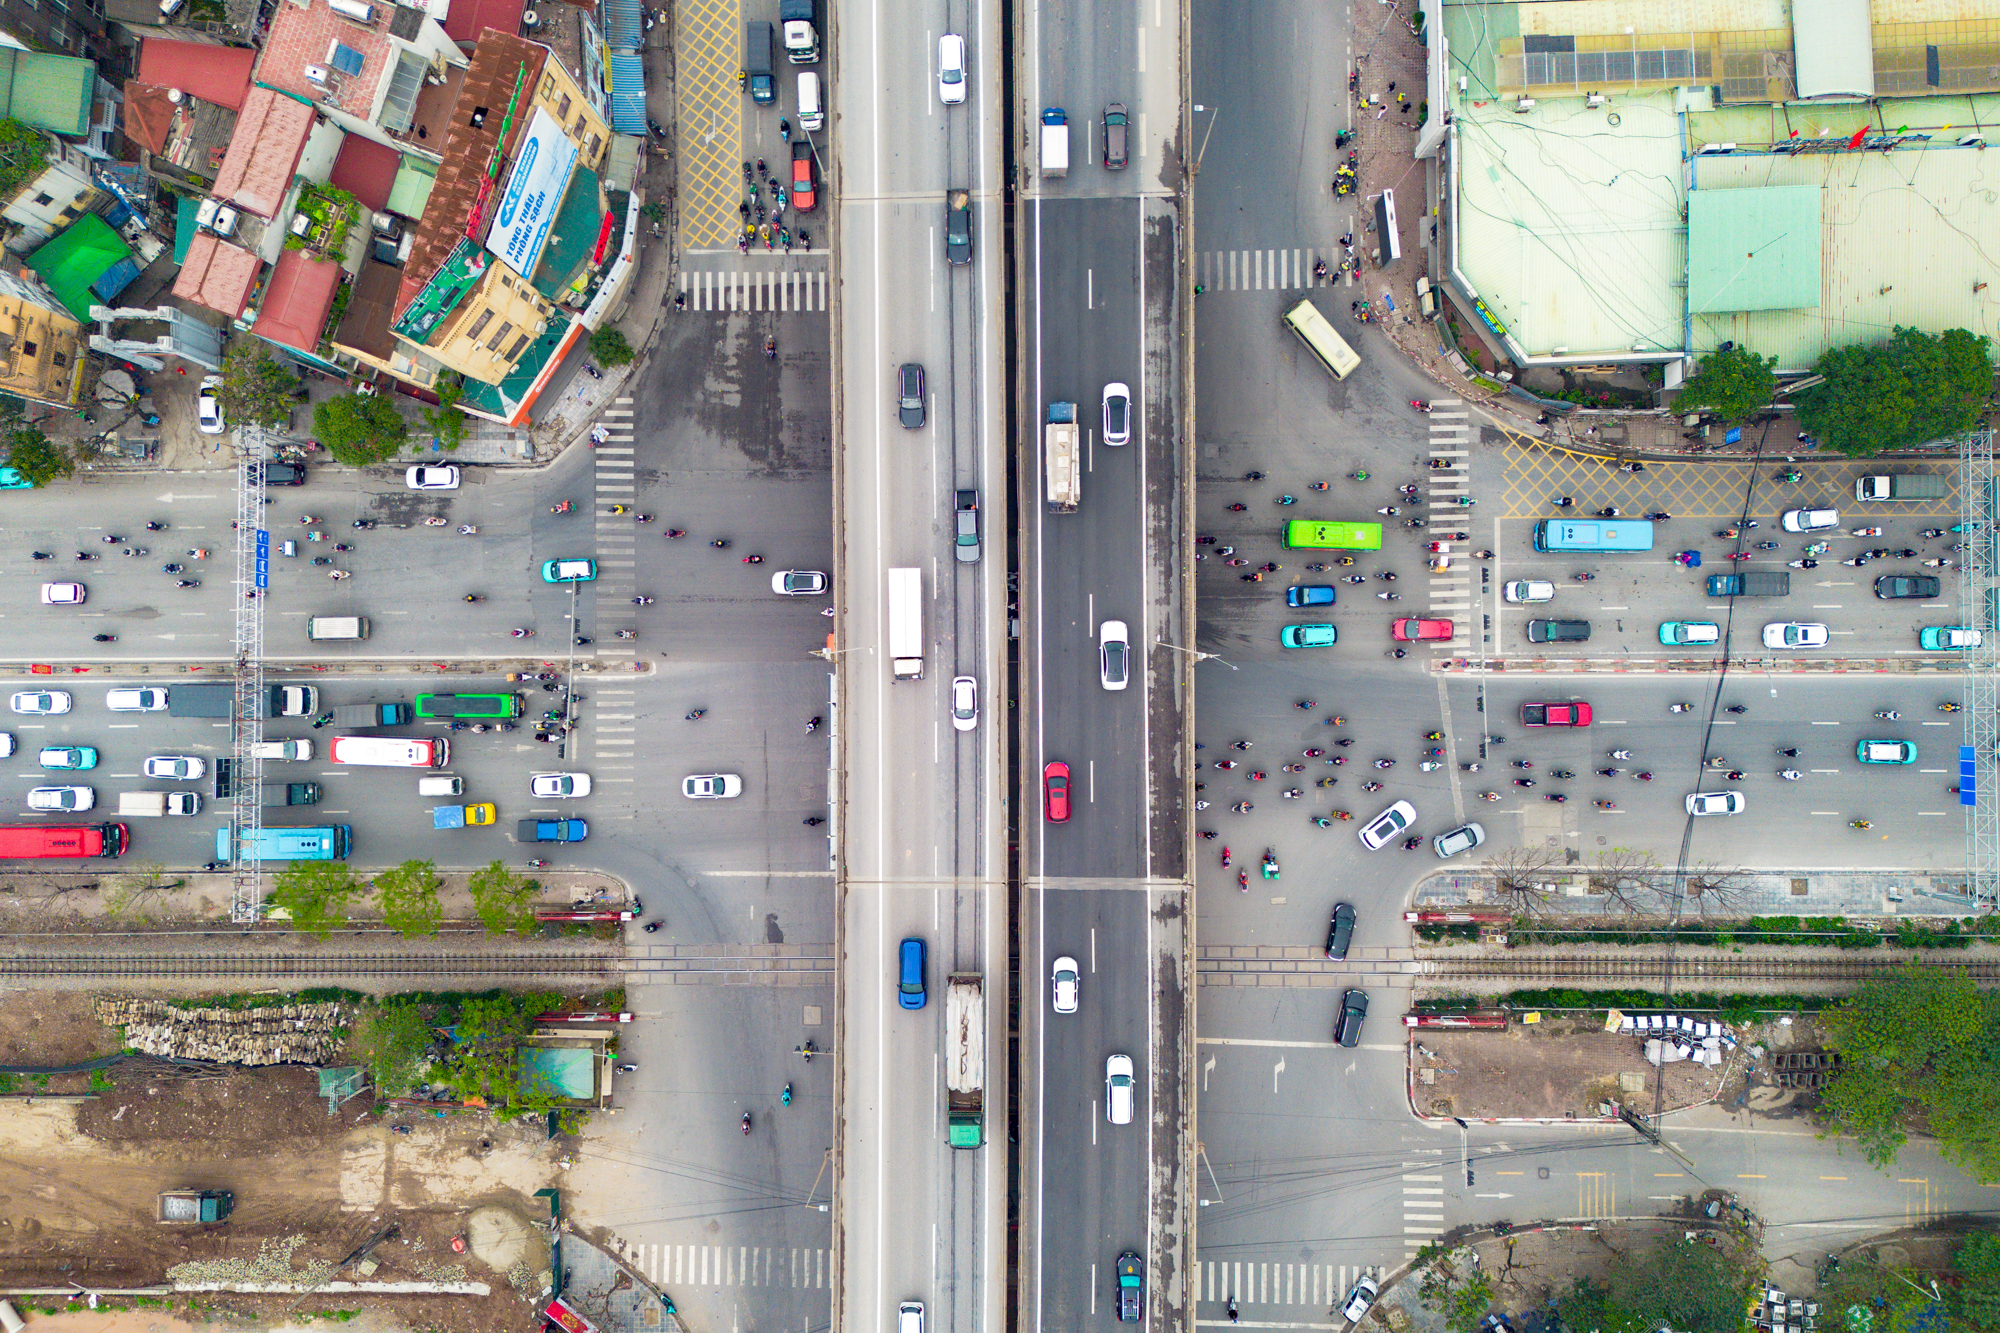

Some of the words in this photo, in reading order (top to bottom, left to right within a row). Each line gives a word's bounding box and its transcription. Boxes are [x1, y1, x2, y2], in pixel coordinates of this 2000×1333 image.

[512, 172, 521, 192] ANH
[519, 141, 533, 172] KHANG
[515, 145, 537, 196] CLEANROOM
[505, 226, 522, 257] TỔNG
[513, 224, 533, 264] PHÒNG
[529, 190, 546, 223] SẠCH
